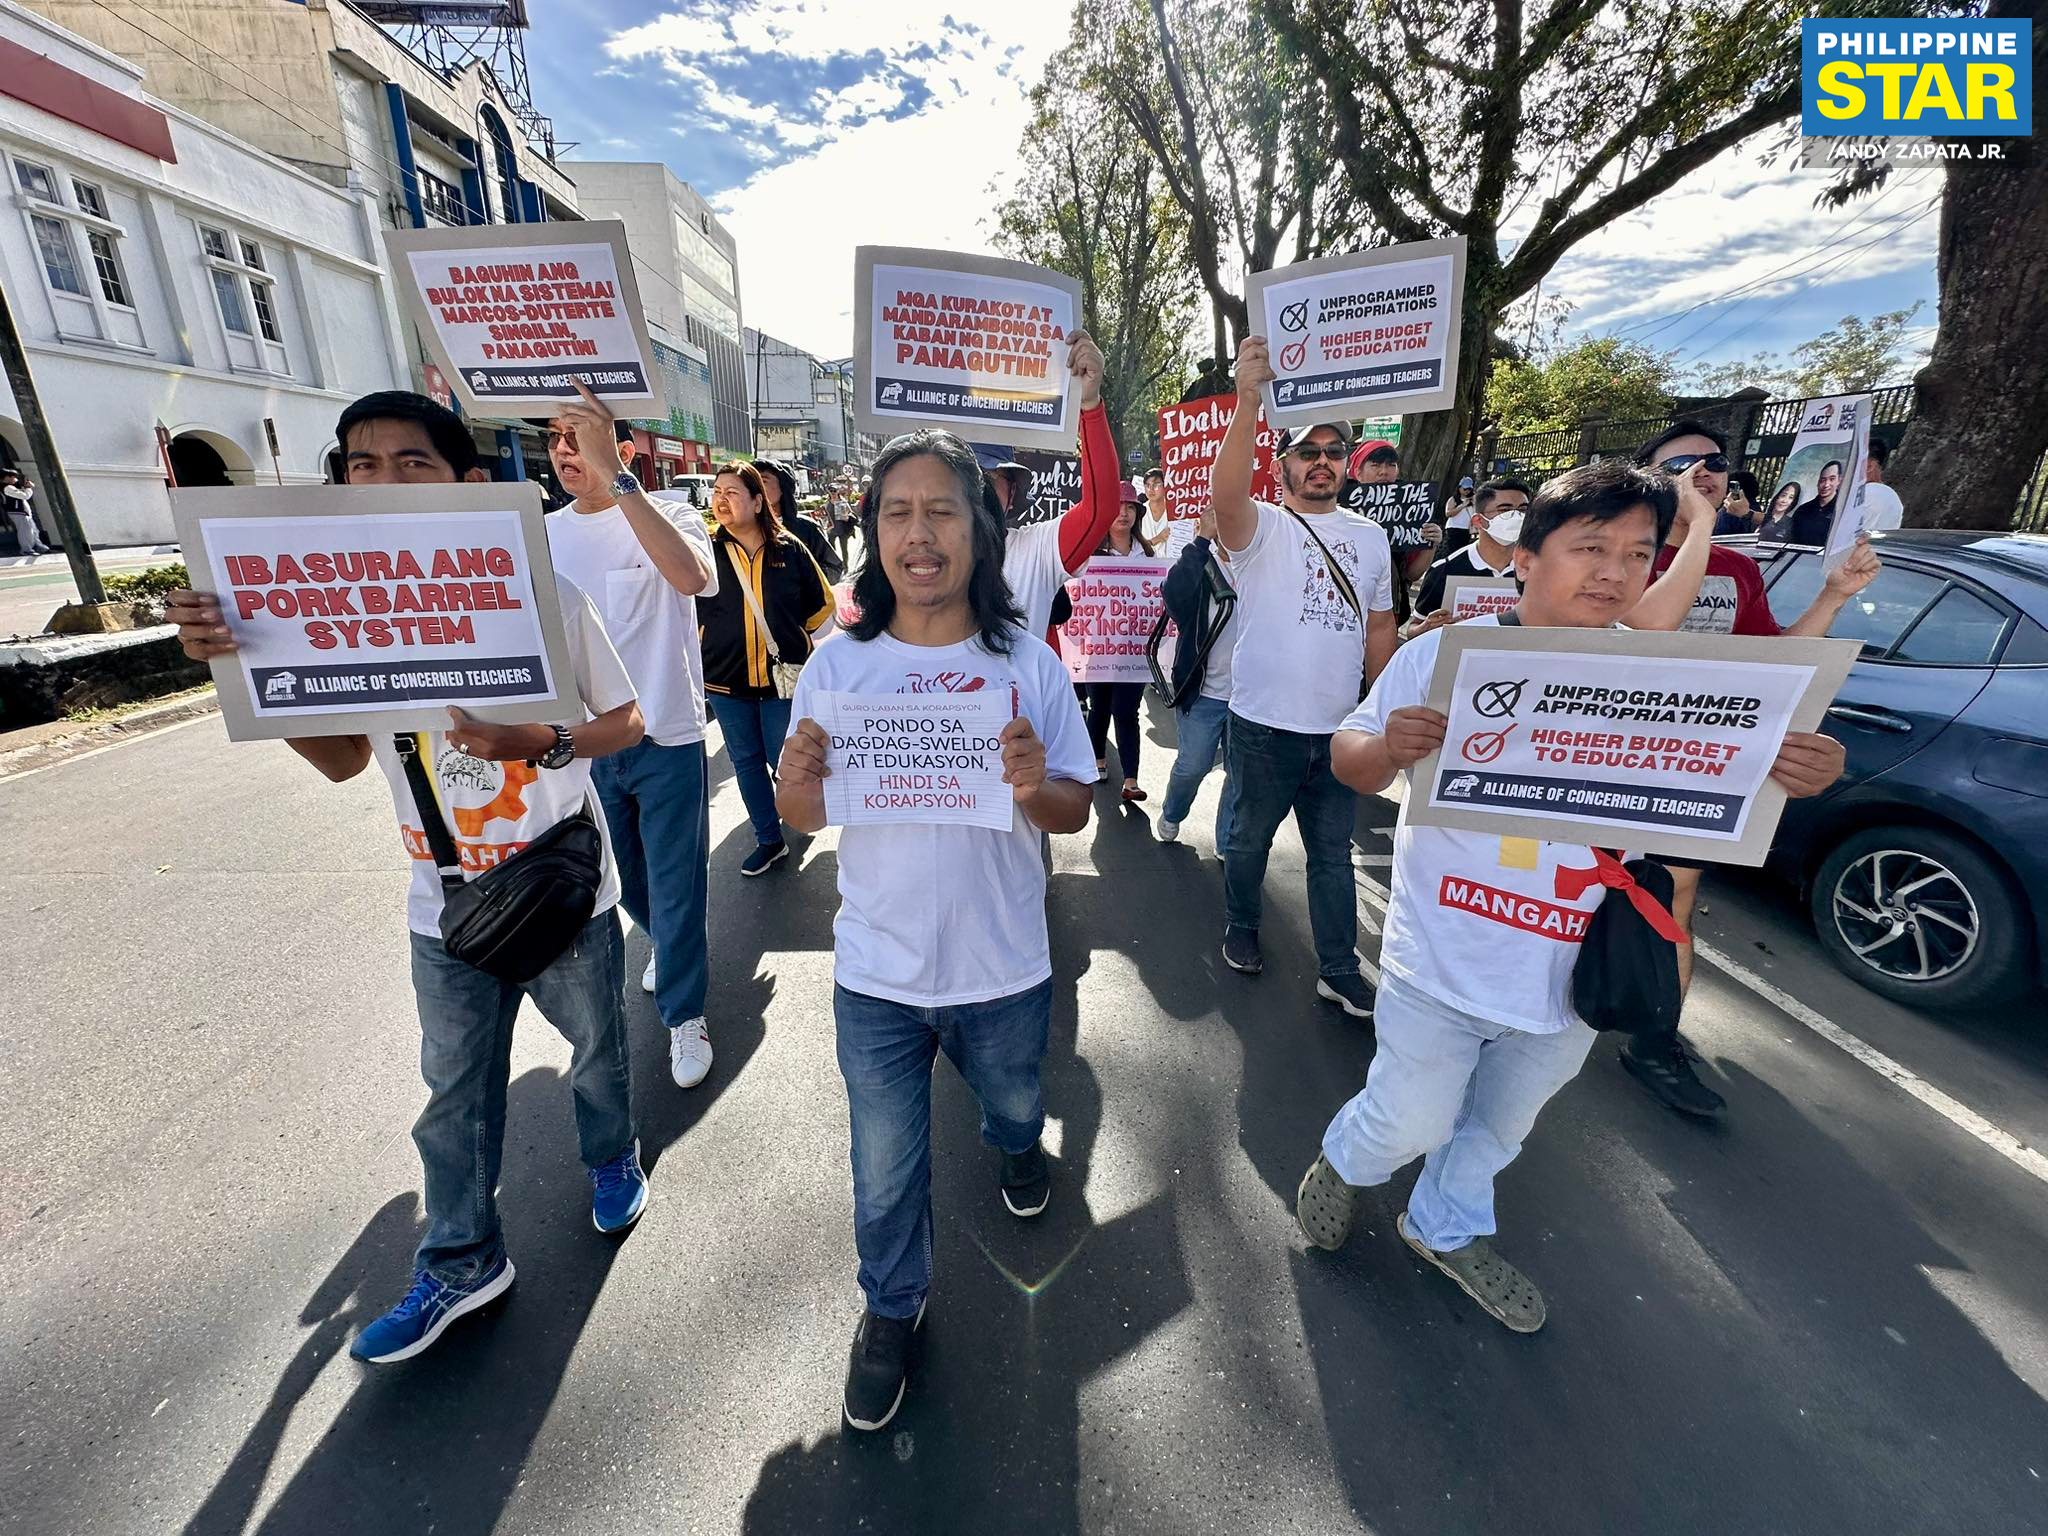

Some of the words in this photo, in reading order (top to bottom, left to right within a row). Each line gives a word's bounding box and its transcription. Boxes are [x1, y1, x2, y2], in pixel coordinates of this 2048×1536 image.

[448, 264, 534, 285] BAGUHIN
[538, 262, 579, 281] ANG
[426, 285, 494, 305] BULOK
[491, 284, 517, 303] NA
[520, 281, 616, 300] SISTEMA!
[1320, 284, 1435, 310] UNPROGRAMMED
[440, 301, 616, 323] MARCOS-DUTERTE
[897, 290, 938, 310] MGA
[941, 295, 1026, 321] KURAKOT
[1027, 306, 1053, 322] AT
[1317, 297, 1438, 324] APPROPRIATIONS
[488, 323, 577, 341] SINGILIN,
[883, 306, 1038, 337] MANDARAMBONG
[1039, 323, 1065, 341] SA
[1320, 330, 1372, 348] HIGHER
[1374, 321, 1433, 340] BUDGET
[481, 340, 598, 359] PANAGUTIN!
[893, 325, 957, 346] KABAN
[959, 332, 983, 348] NG
[986, 336, 1052, 358] BAYAN,
[1323, 347, 1343, 361] TO
[1344, 336, 1427, 358] EDUCATION
[897, 343, 1047, 379] PANAGUTIN!
[491, 375, 530, 387] ALLIANCE
[528, 375, 540, 387] OF
[592, 371, 637, 385] TEACHERS
[1297, 381, 1333, 396] ALLIANCE
[1334, 379, 1345, 391] OF
[1346, 374, 1391, 390] CONCERNED
[1392, 367, 1433, 384] TEACHERS
[906, 389, 947, 405] ALLIANCE
[948, 394, 960, 407] OF
[961, 395, 1010, 412] CONCERNED
[1012, 399, 1054, 416] TEACHERS
[1803, 414, 1832, 429] ACT
[1042, 487, 1062, 497] ANG
[1349, 484, 1398, 507] SAVE
[1401, 483, 1430, 503] THE
[1405, 502, 1434, 522] CITY
[224, 548, 426, 586] IBASURA
[431, 546, 515, 579] ANG
[233, 586, 359, 620] PORK
[359, 581, 522, 615] BARREL
[1457, 604, 1496, 614] BULOK
[304, 615, 476, 650] SYSTEM
[304, 675, 368, 693] ALLIANCE
[370, 675, 388, 692] OF
[390, 670, 464, 690] CONCERNED
[465, 667, 532, 686] TEACHERS
[842, 704, 871, 712] GURO
[871, 704, 904, 713] LABAN
[906, 704, 921, 712] SA
[922, 703, 982, 713] KORAPSYON
[1543, 683, 1762, 712] UNPROGRAMMED
[864, 719, 935, 733] PONDO
[940, 719, 965, 733] SA
[1531, 700, 1760, 729] APPROPRIATIONS
[832, 736, 1001, 751] DAGDAG-SWELDO
[1530, 728, 1623, 750] HIGHER
[1628, 735, 1741, 762] BUDGET
[846, 754, 867, 768] AT
[874, 754, 989, 772] EDUKASYON,
[1535, 745, 1567, 762] TO
[1570, 748, 1727, 777] EDUCATION
[879, 775, 933, 790] HINDI
[937, 775, 960, 790] SA
[864, 794, 976, 809] KORAPSYON!
[1481, 781, 1544, 801] ALLIANCE
[1546, 786, 1565, 803] OF
[1566, 788, 1648, 811] CONCERNED
[1651, 797, 1726, 820] TEACHERS
